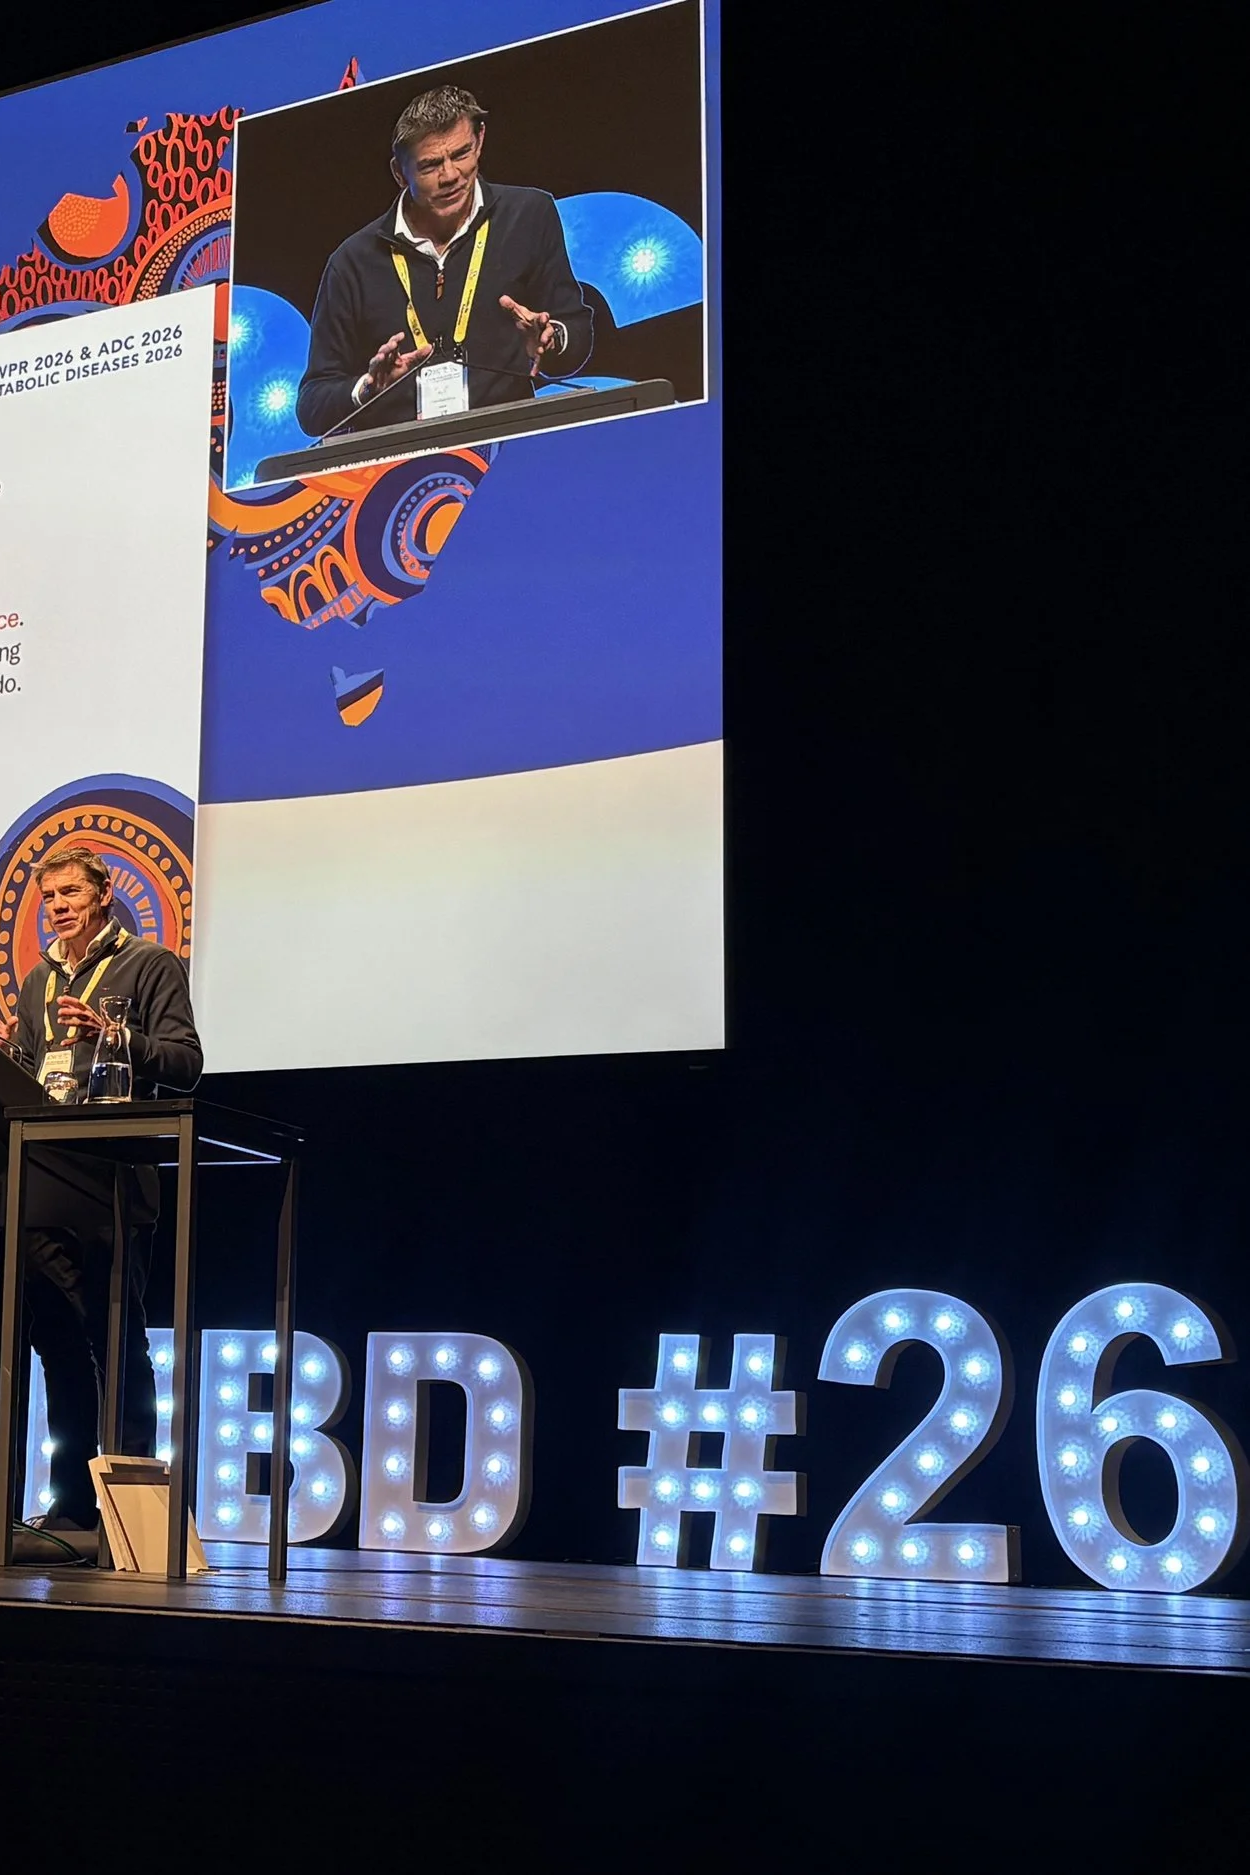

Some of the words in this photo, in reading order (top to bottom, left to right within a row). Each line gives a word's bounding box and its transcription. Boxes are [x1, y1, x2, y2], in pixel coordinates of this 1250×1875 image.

[35, 350, 74, 371] 2026
[80, 346, 92, 360] &
[98, 336, 135, 357] ADC
[141, 325, 182, 346] 2026
[66, 353, 139, 381] DISEASES
[145, 344, 183, 364] 2026
[618, 1282, 1238, 1594] #26
